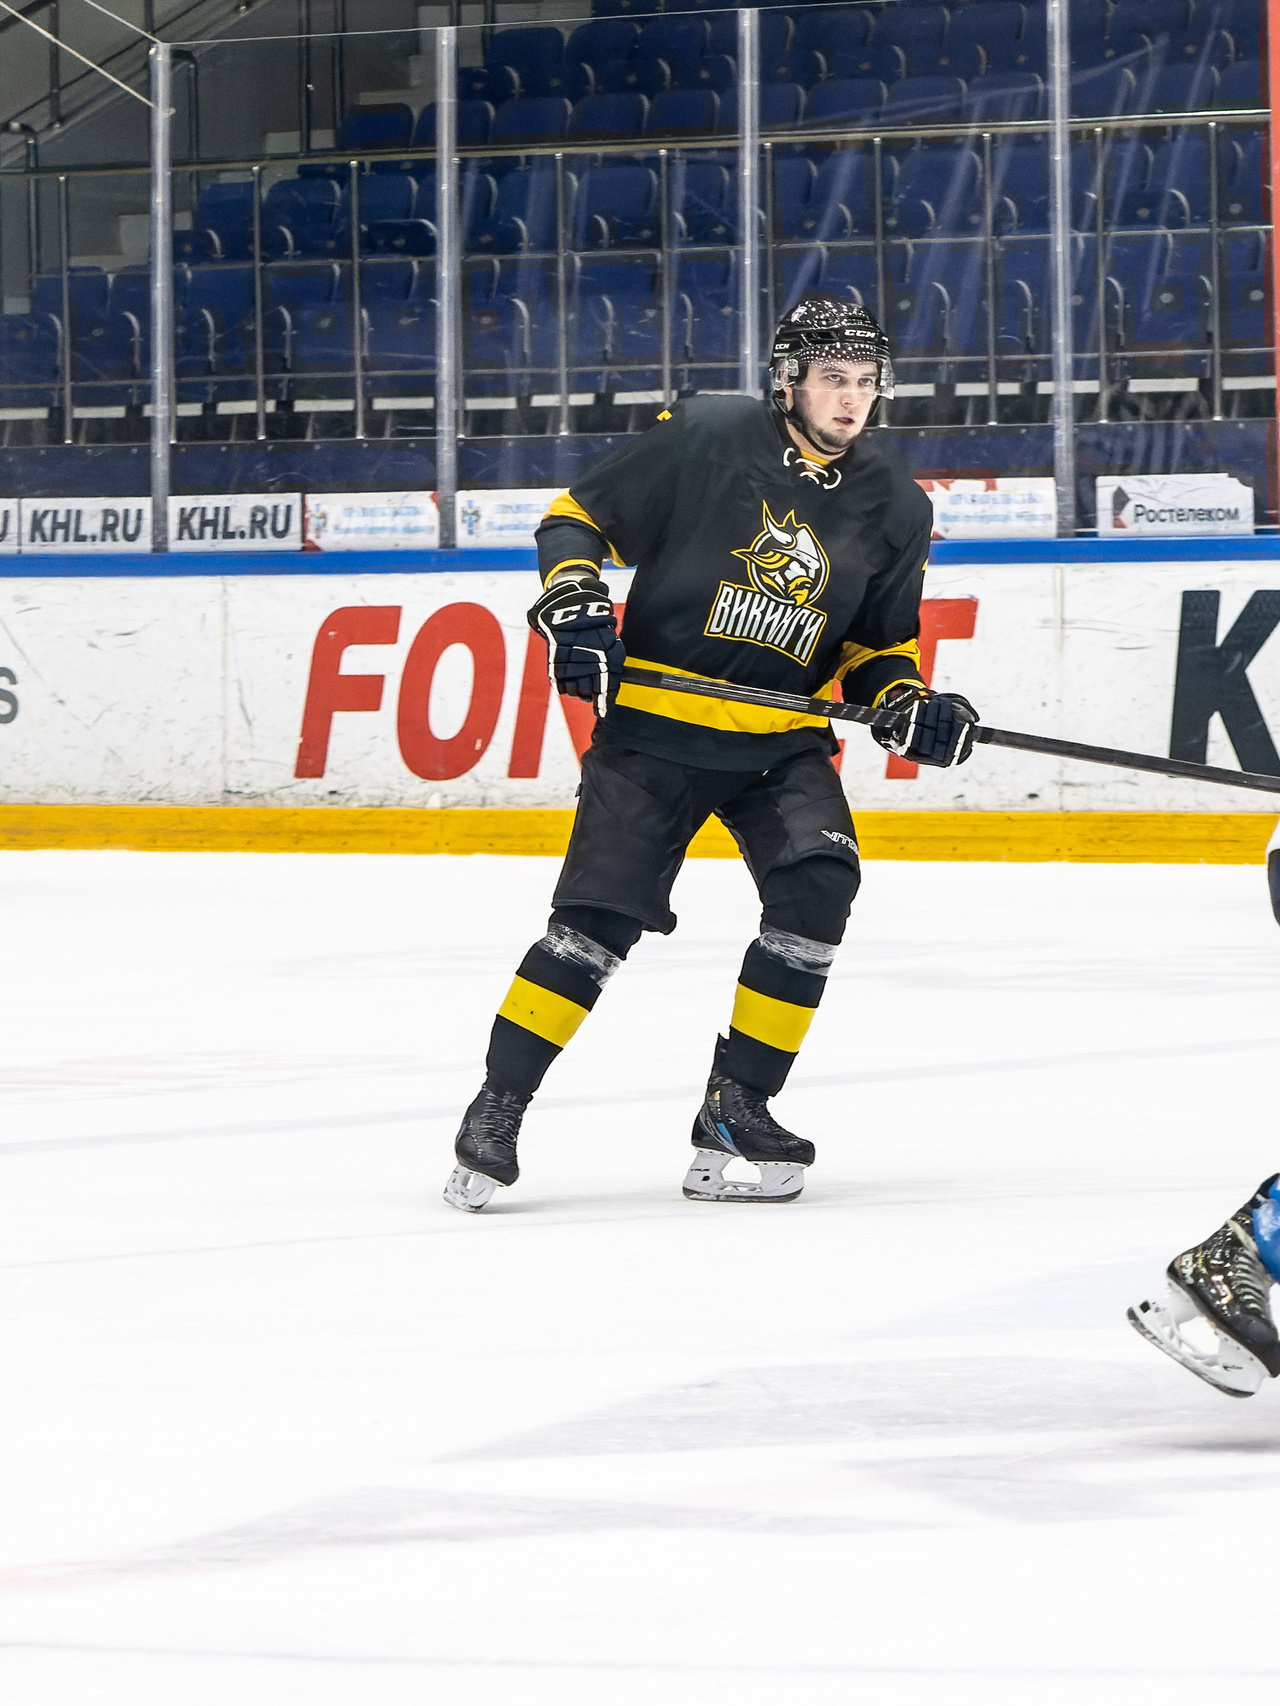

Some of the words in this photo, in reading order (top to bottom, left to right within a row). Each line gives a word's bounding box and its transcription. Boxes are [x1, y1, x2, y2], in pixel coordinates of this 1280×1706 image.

[844, 329, 877, 339] CCM
[29, 508, 144, 543] KHL.RU
[177, 504, 293, 541] KHL.RU
[1134, 504, 1240, 525] Ростелеком
[709, 586, 824, 661] ВИКИНГИ
